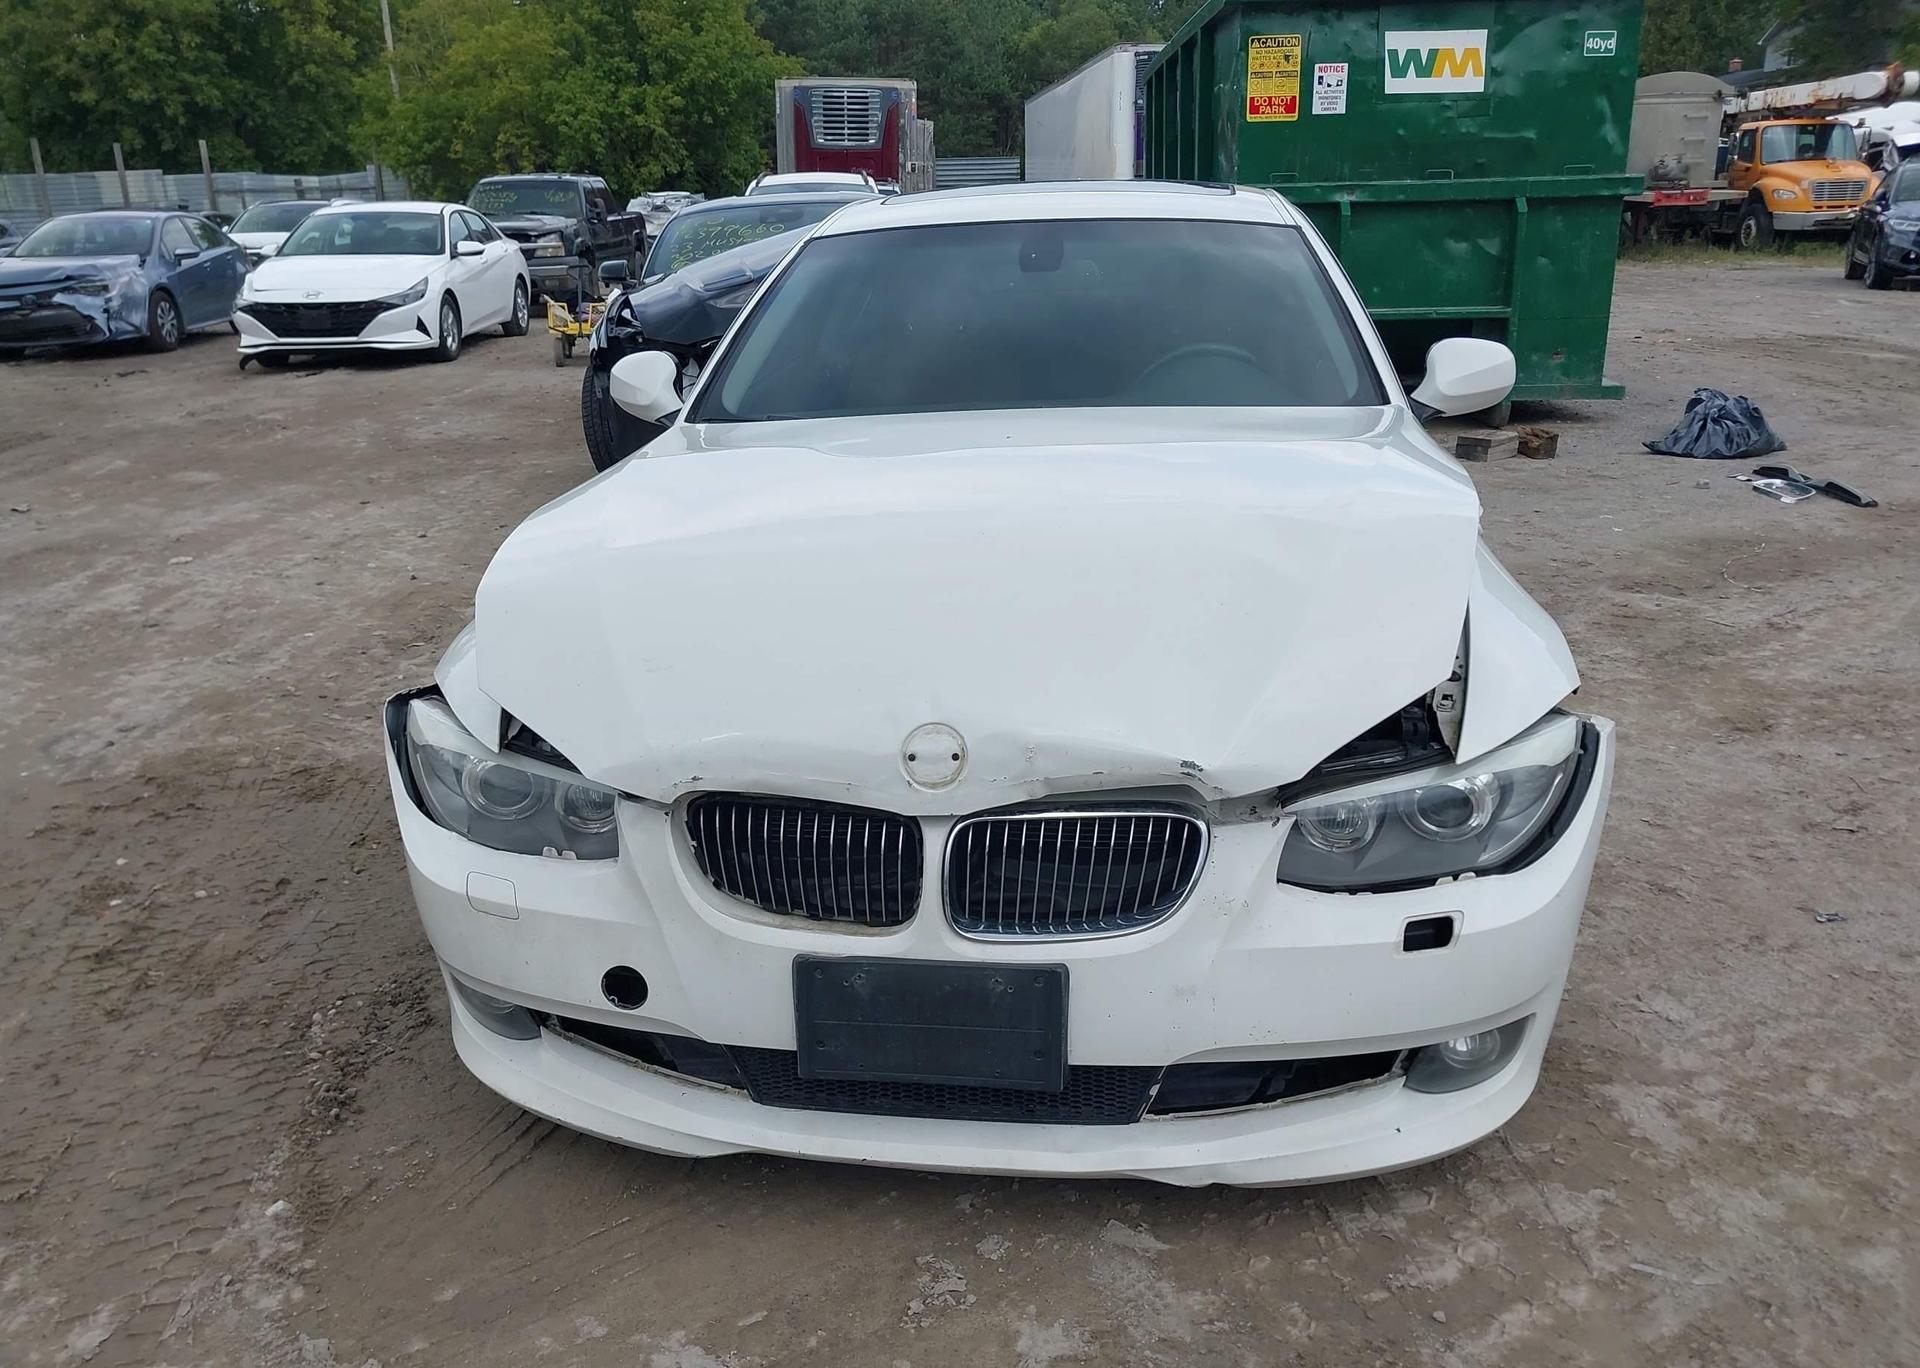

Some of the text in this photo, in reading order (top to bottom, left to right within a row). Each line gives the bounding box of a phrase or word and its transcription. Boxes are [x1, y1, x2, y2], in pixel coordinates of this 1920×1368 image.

[1260, 37, 1299, 48] CAUTION
[1586, 37, 1616, 52] 40yd
[1387, 47, 1484, 78] WM
[1318, 65, 1345, 73] NOTICE
[1254, 96, 1292, 106] DO NOT
[1259, 105, 1287, 114] PARK
